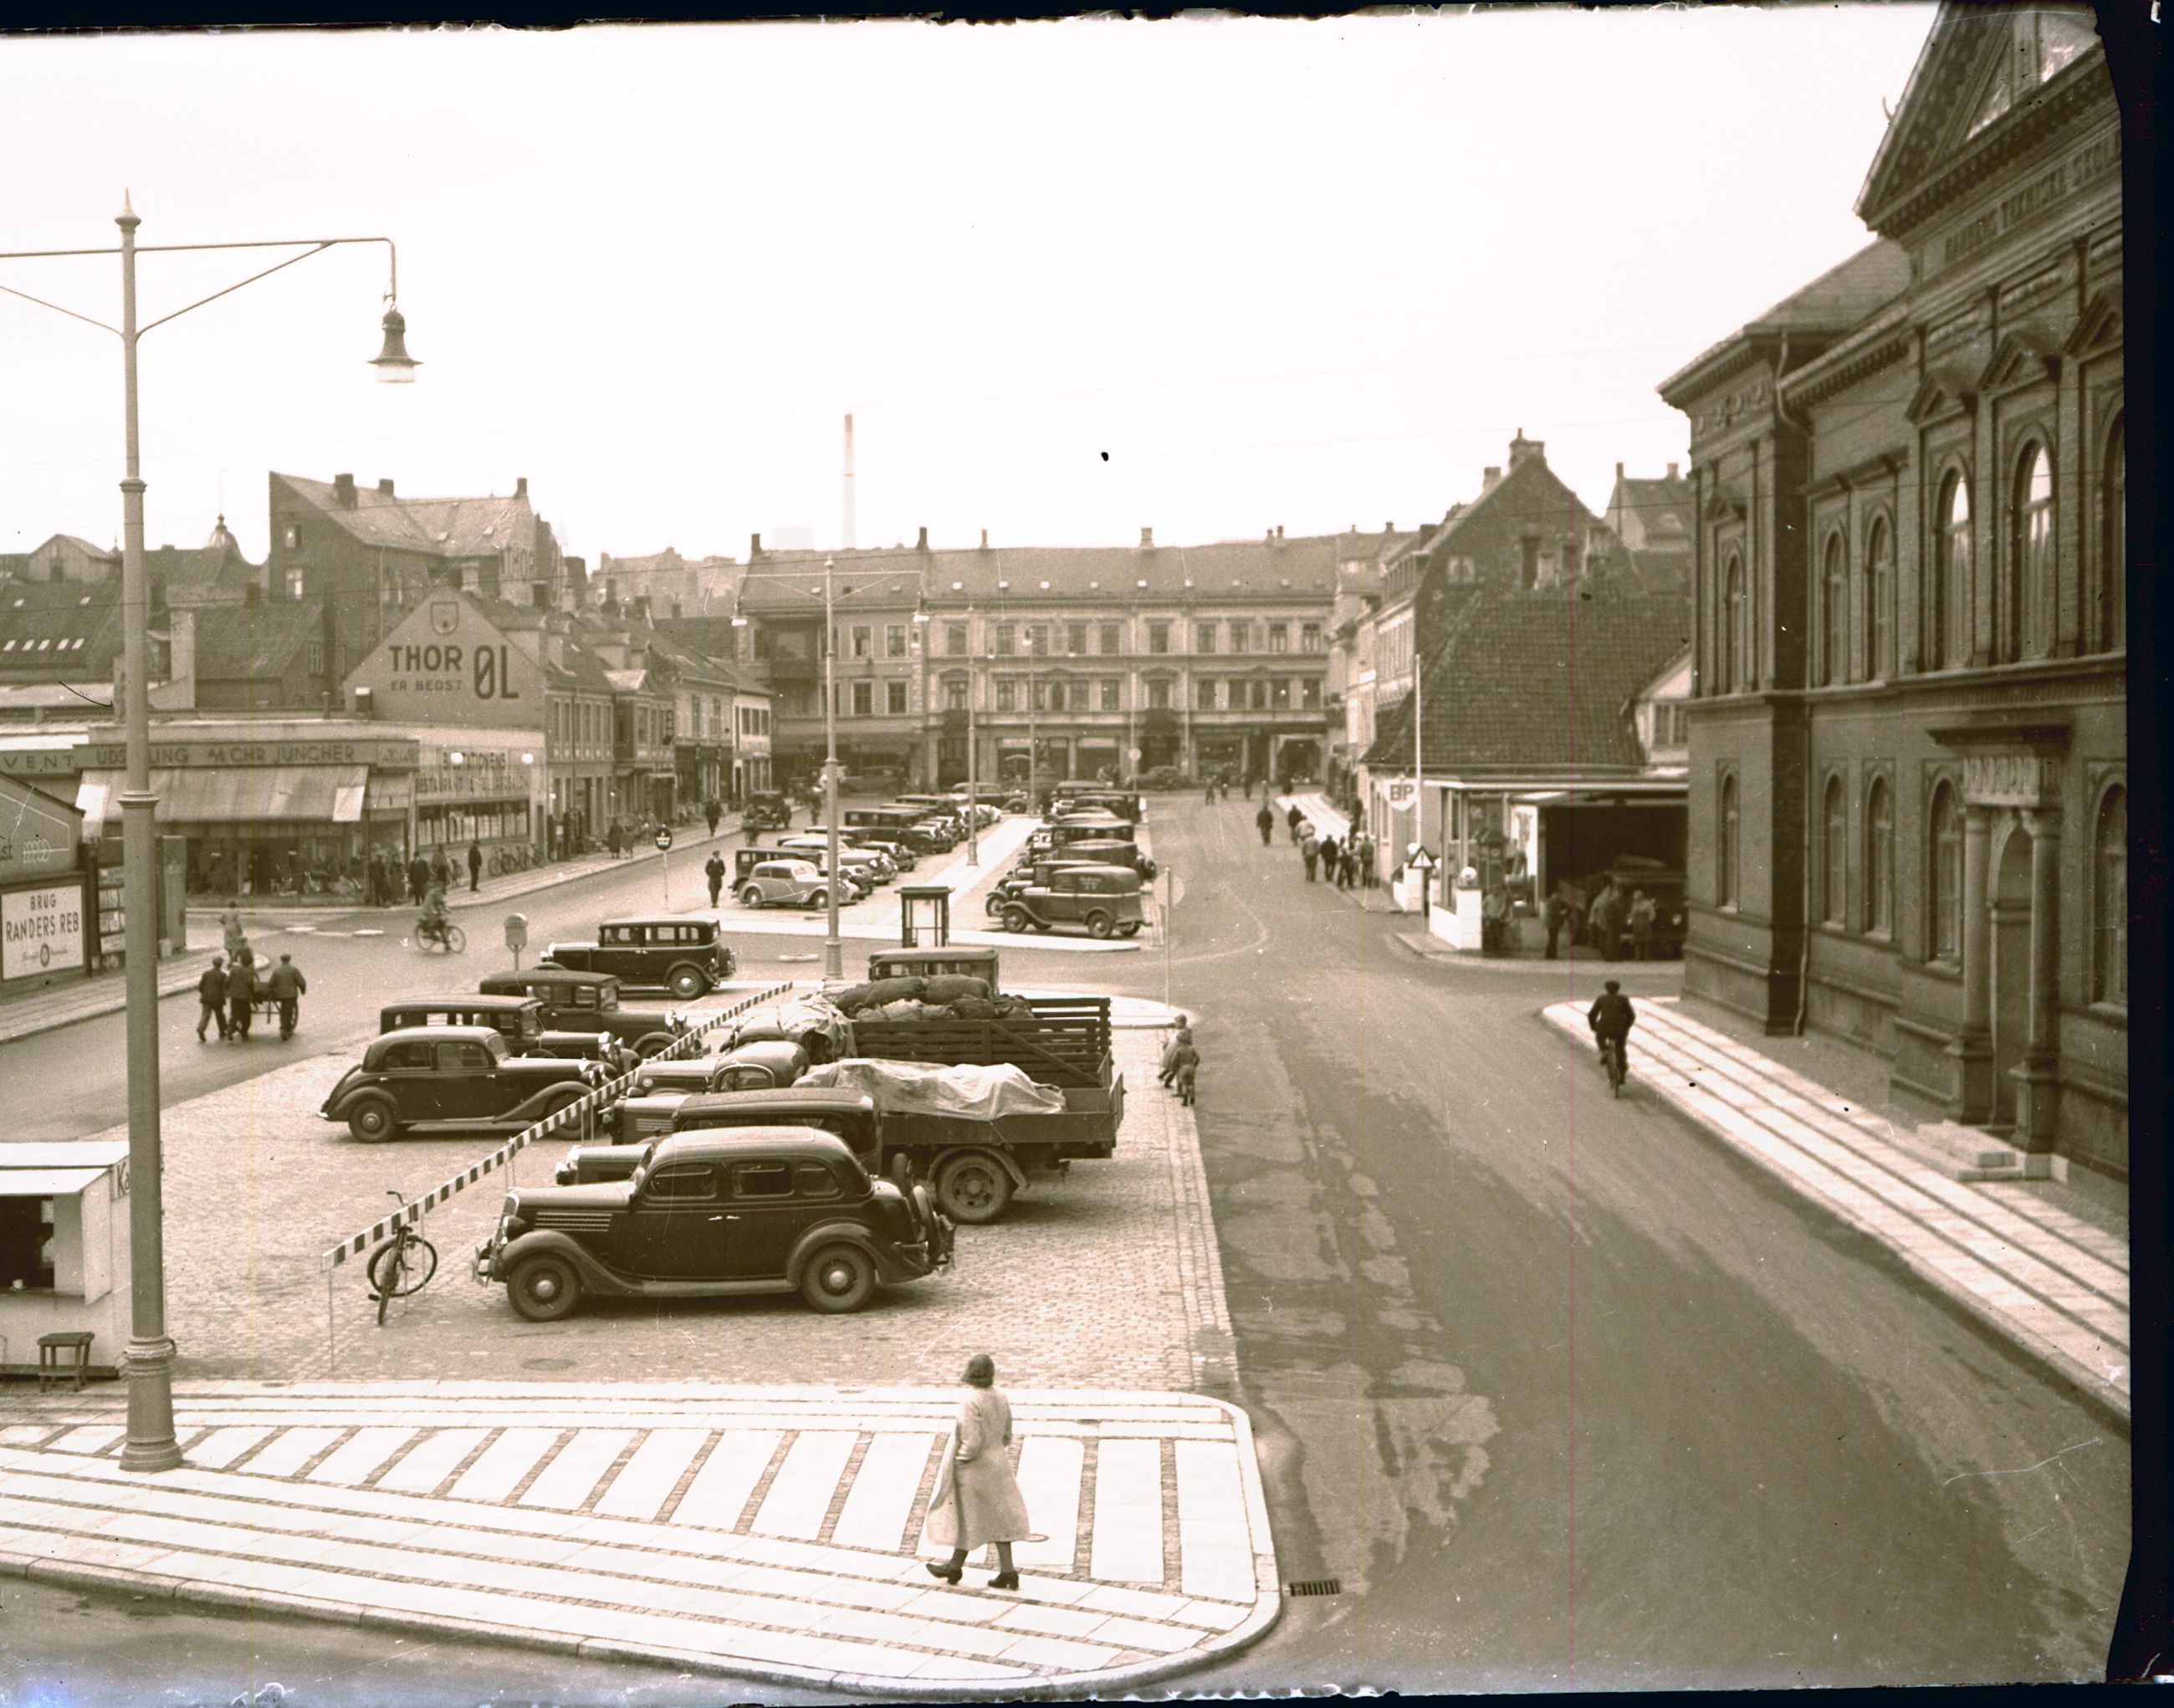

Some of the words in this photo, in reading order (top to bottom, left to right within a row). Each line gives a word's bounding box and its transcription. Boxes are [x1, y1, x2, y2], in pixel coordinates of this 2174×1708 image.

[388, 645, 463, 671] THOR
[473, 644, 519, 699] ØL
[391, 680, 407, 692] ER
[416, 679, 463, 692] BEDST
[96, 747, 189, 765] UDSLING
[274, 744, 355, 764] JUNCHER
[1389, 784, 1414, 801] BP
[30, 893, 56, 910] BRUG
[6, 915, 55, 943] RANDERS
[59, 912, 79, 933] REB
